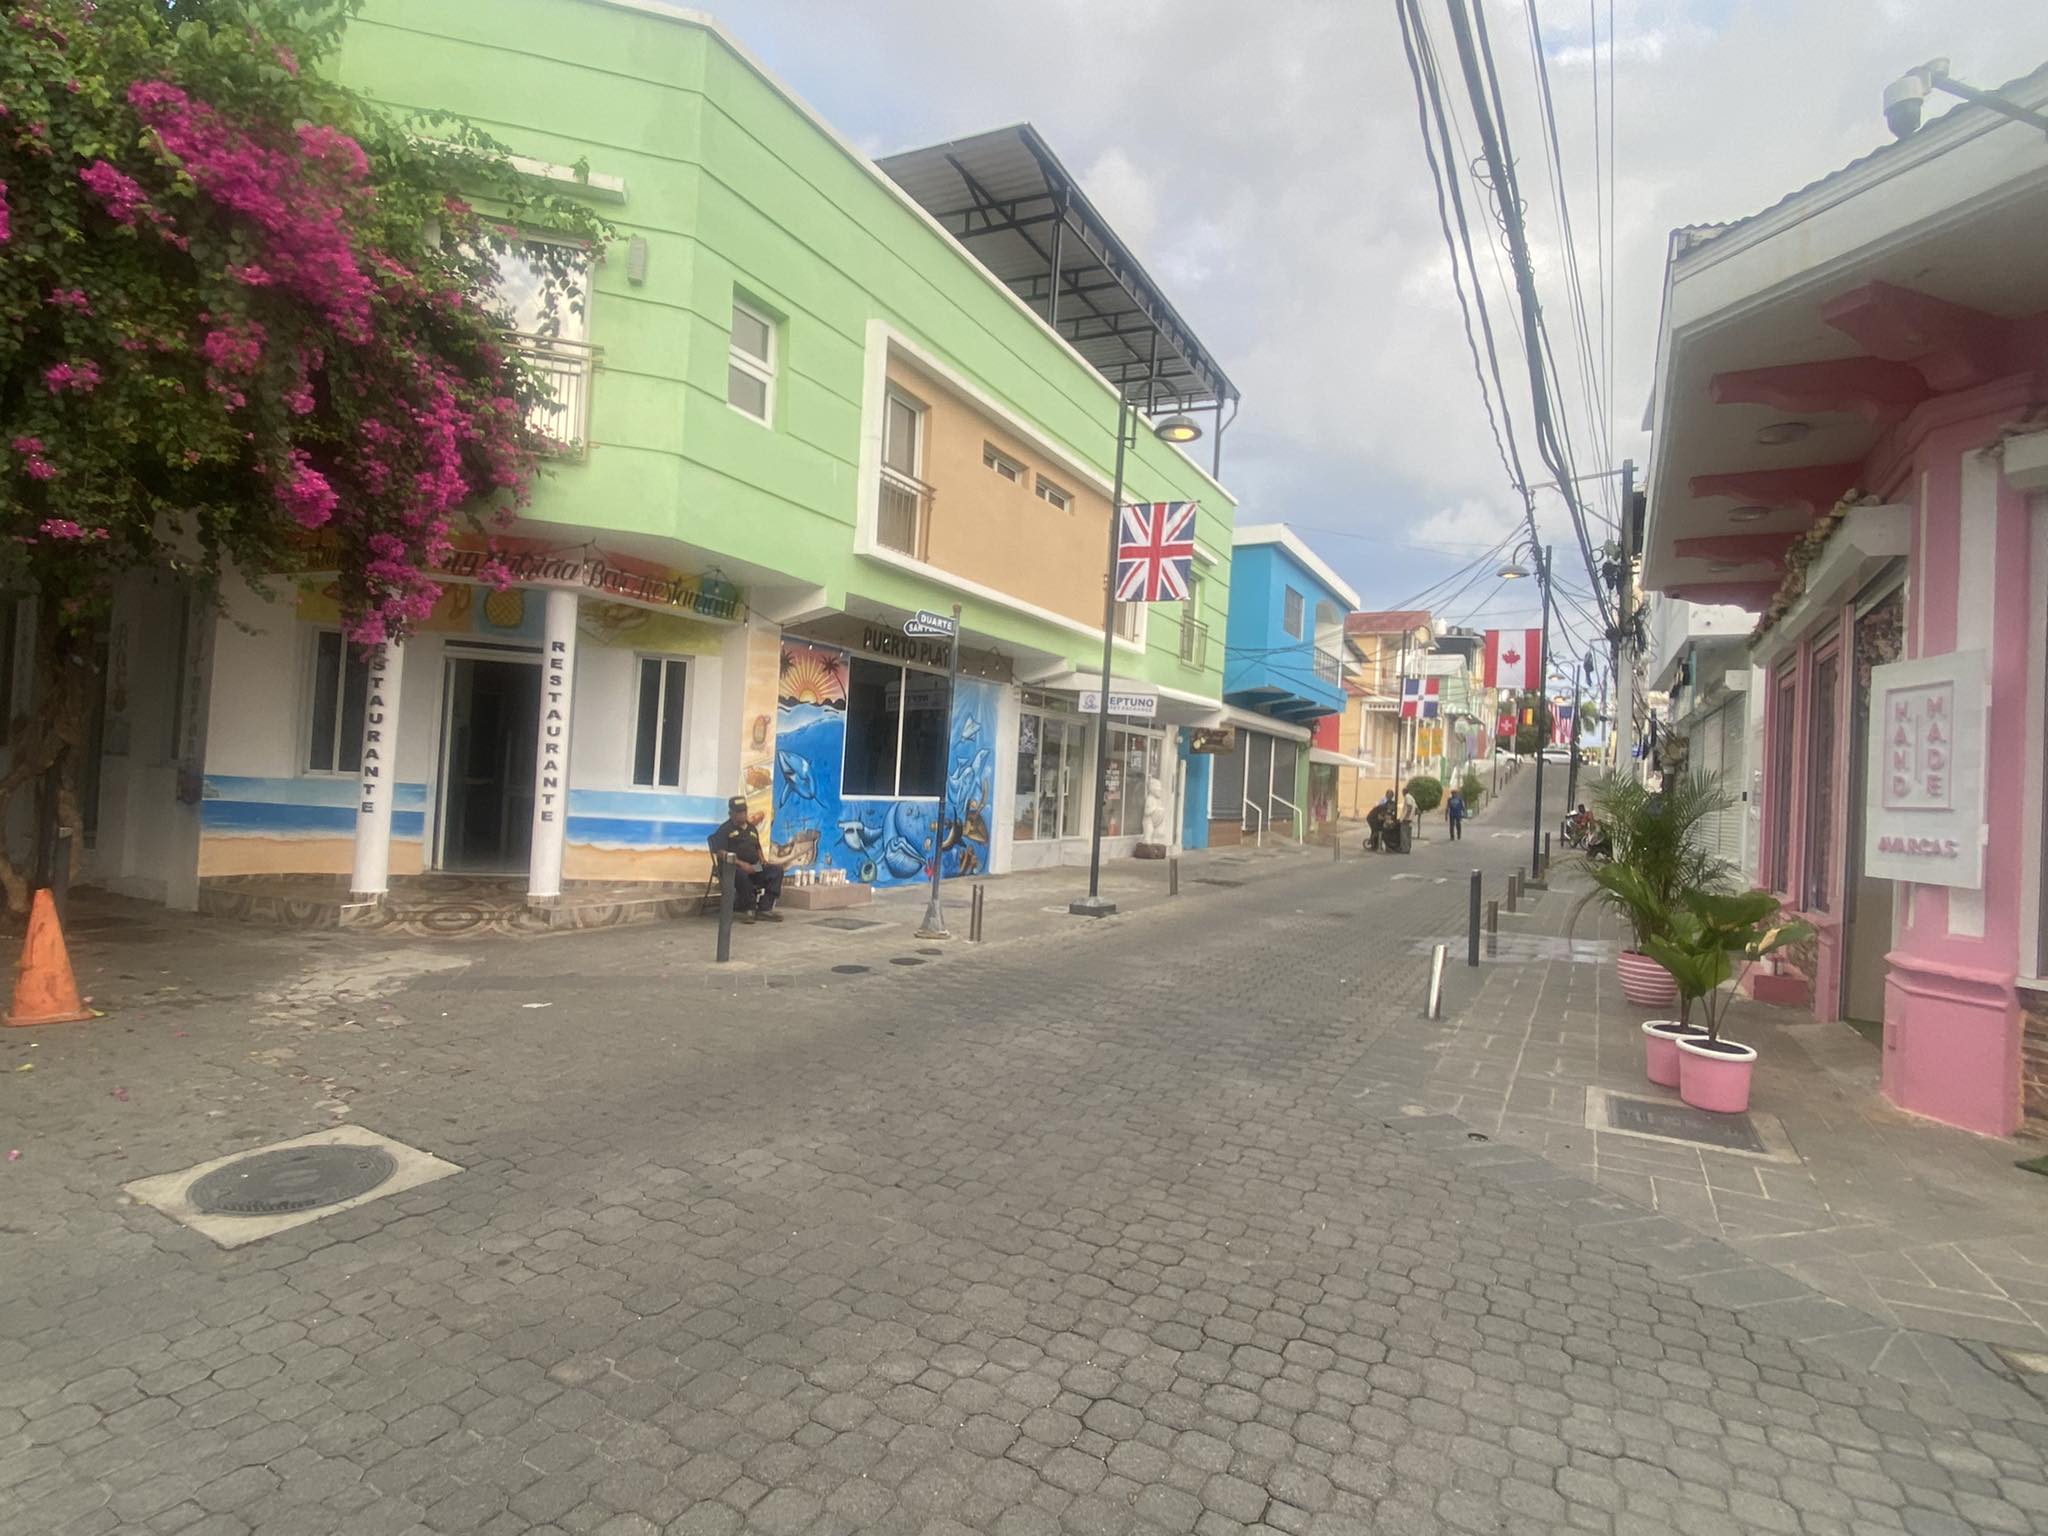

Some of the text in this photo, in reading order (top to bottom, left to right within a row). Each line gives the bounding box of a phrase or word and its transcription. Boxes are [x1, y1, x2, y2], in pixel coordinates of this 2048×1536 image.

[863, 626, 951, 669] PUERTO PLAT
[920, 613, 953, 631] DUARTE
[361, 642, 388, 813] ESTAURANTE
[541, 641, 565, 822] RESTAURANTE
[1109, 697, 1154, 708] EPTUNO
[1893, 701, 1910, 798] HAND
[1926, 697, 1944, 797] MADE
